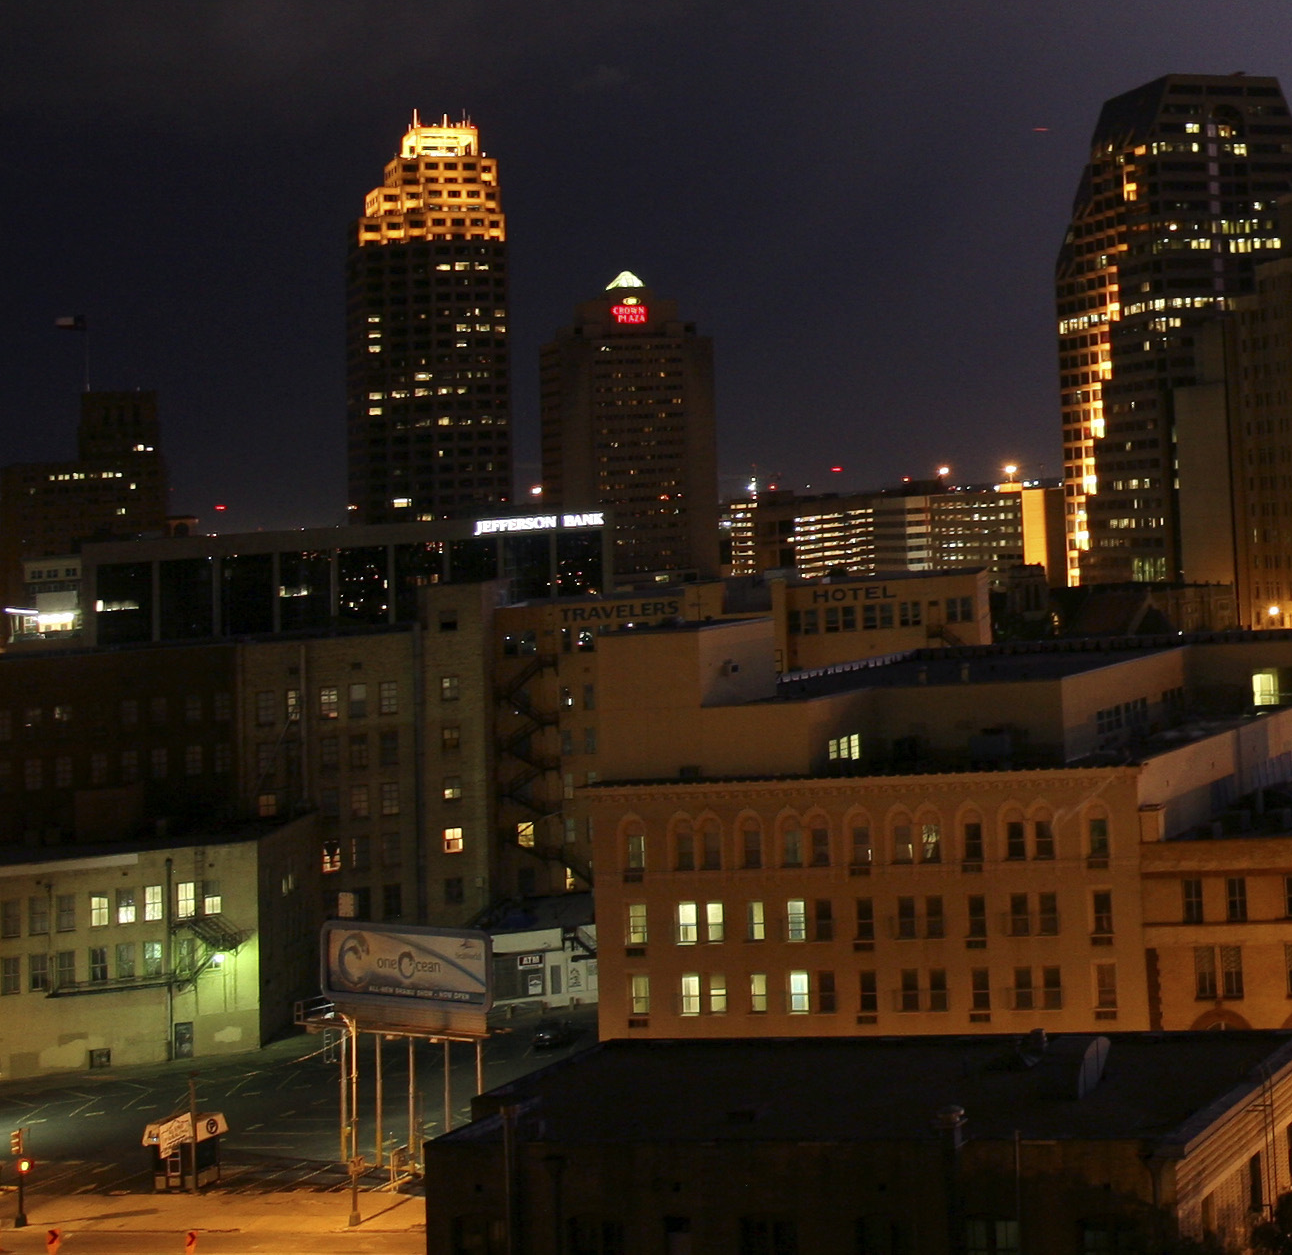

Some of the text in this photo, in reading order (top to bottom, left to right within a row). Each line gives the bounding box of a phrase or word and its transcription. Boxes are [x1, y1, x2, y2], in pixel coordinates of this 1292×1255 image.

[618, 315, 646, 323] PLAZA
[474, 512, 604, 535] JEFFERSON BANK
[813, 586, 897, 603] HOTEL
[560, 600, 679, 622] TRAVELERS
[522, 955, 540, 964] ATM
